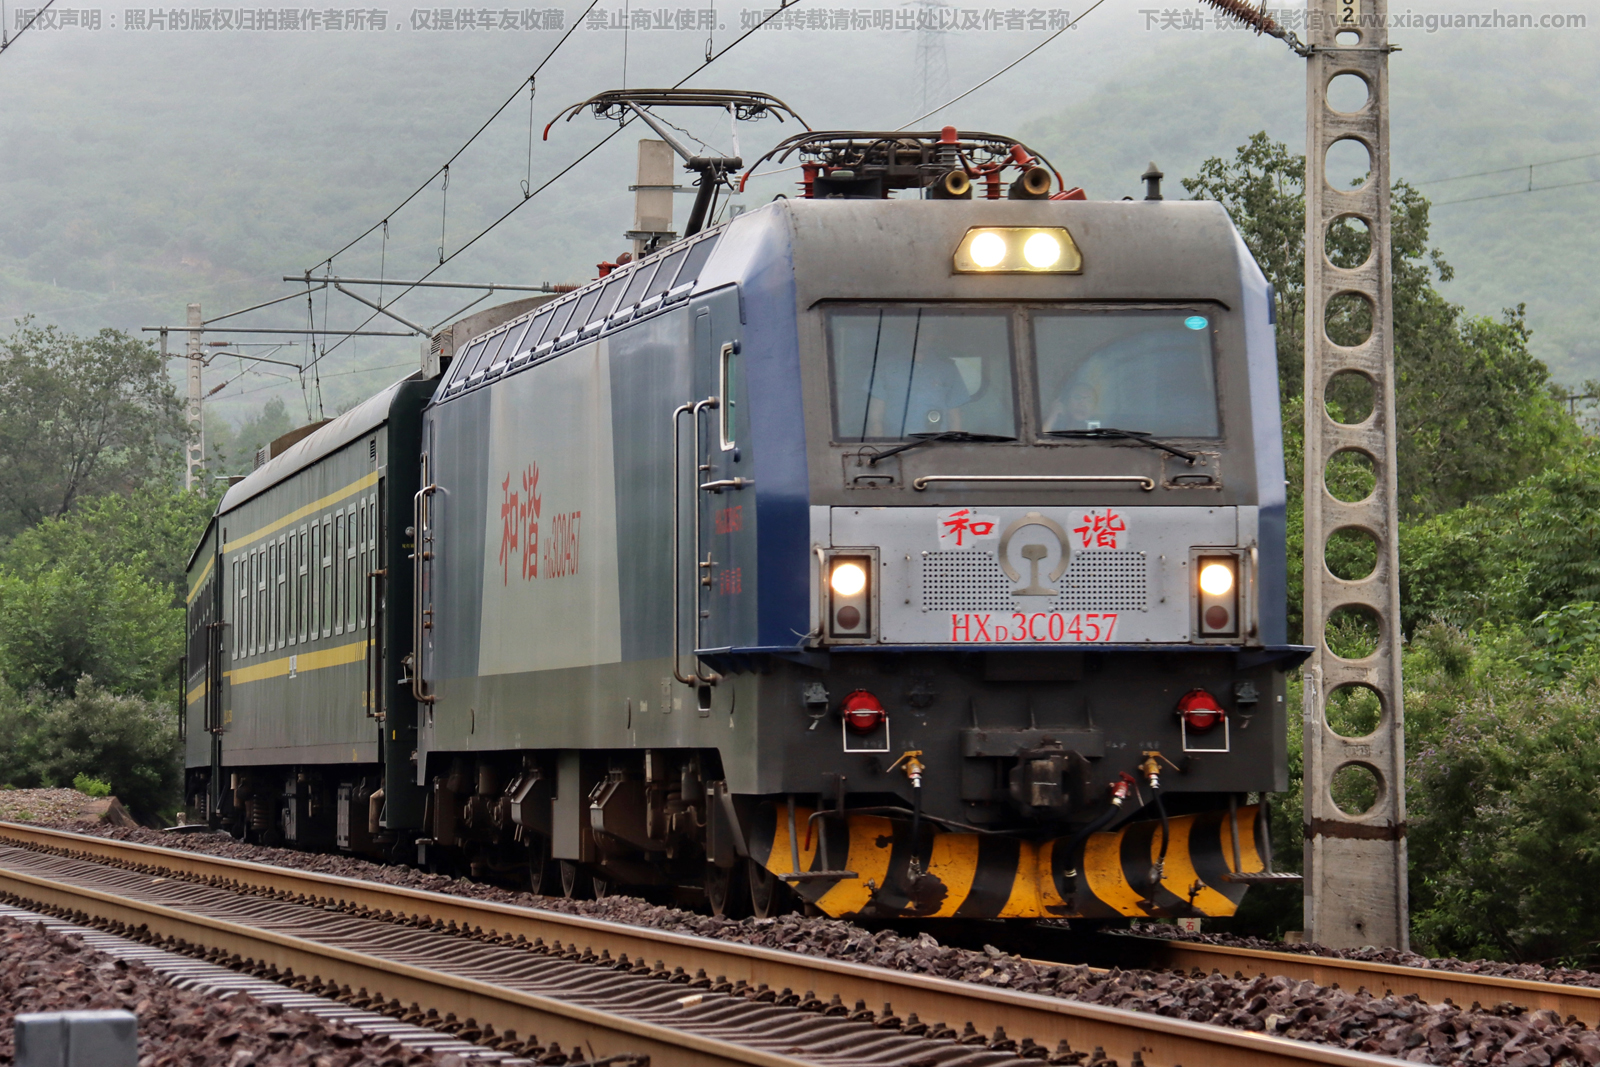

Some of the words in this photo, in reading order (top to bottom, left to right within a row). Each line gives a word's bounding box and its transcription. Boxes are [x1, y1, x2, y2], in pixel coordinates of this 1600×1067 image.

[499, 460, 541, 587] 和谐
[941, 508, 995, 546] 和
[1073, 508, 1126, 549] 谐
[951, 613, 1118, 642] HXD3C0457
[1186, 918, 1194, 930] 石
